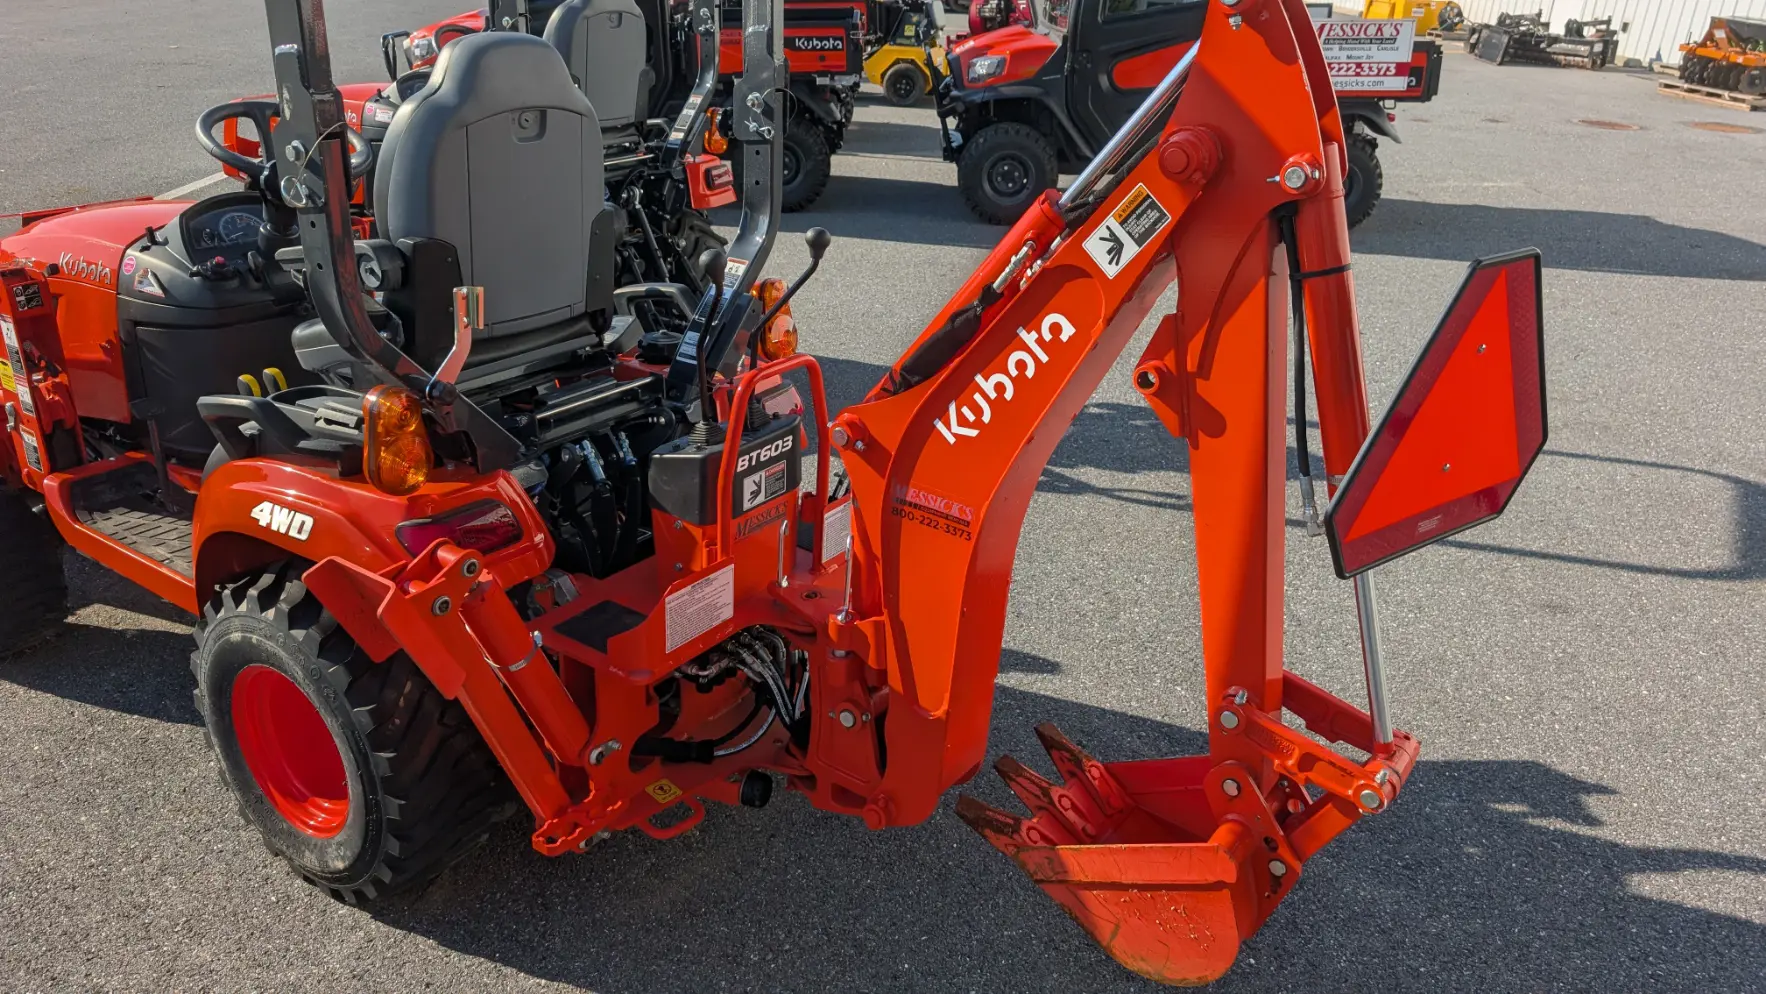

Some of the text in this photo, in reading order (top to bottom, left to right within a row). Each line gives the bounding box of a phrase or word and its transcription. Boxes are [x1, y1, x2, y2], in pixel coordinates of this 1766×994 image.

[795, 37, 843, 50] Kubota
[1334, 79, 1385, 88] essicks.com
[1121, 190, 1144, 213] WARNING
[59, 251, 112, 285] Kubota
[933, 313, 1076, 445] Kubota
[736, 435, 793, 472] BT603
[250, 500, 314, 541] 4WD
[734, 500, 788, 541] MESSICK'S
[891, 506, 972, 542] 800-222-3373
